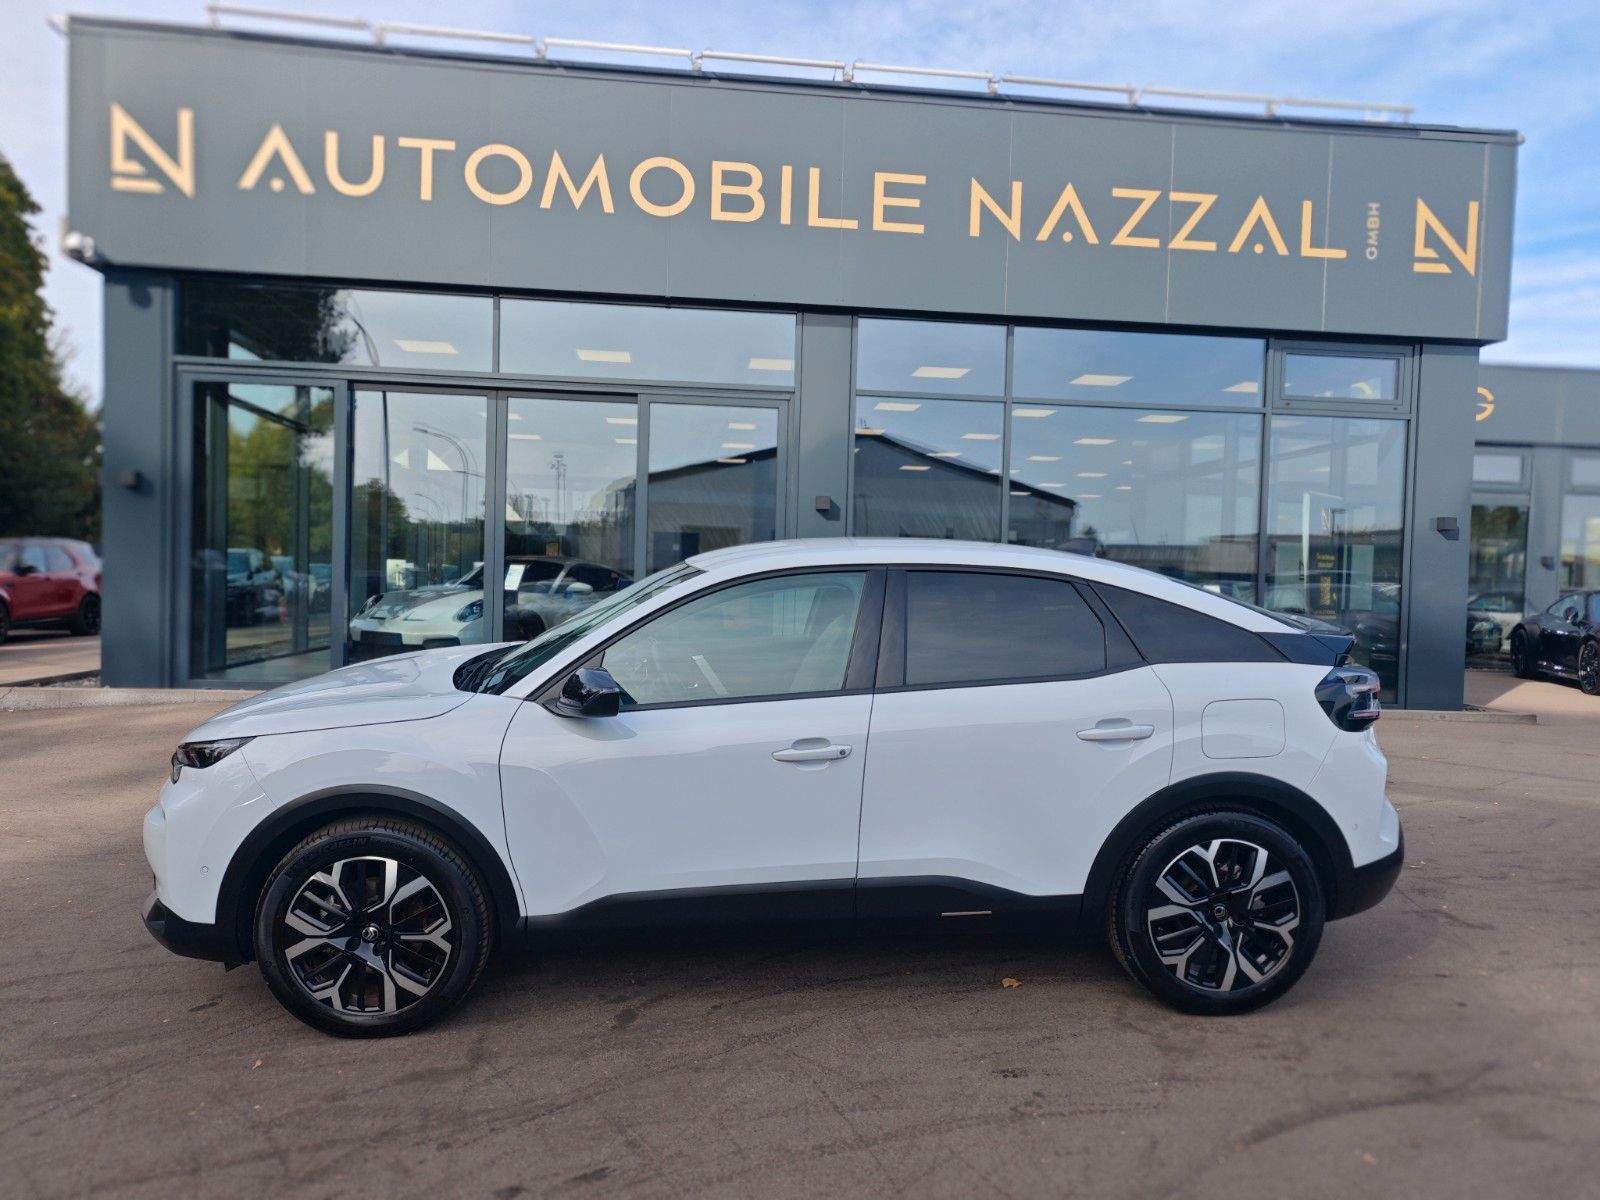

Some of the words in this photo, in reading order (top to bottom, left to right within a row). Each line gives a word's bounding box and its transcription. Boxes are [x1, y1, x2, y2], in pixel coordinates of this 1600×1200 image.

[237, 122, 927, 235] AUTOMOBILE
[968, 177, 1348, 259] NAZZAL
[1365, 202, 1381, 260] GMBH
